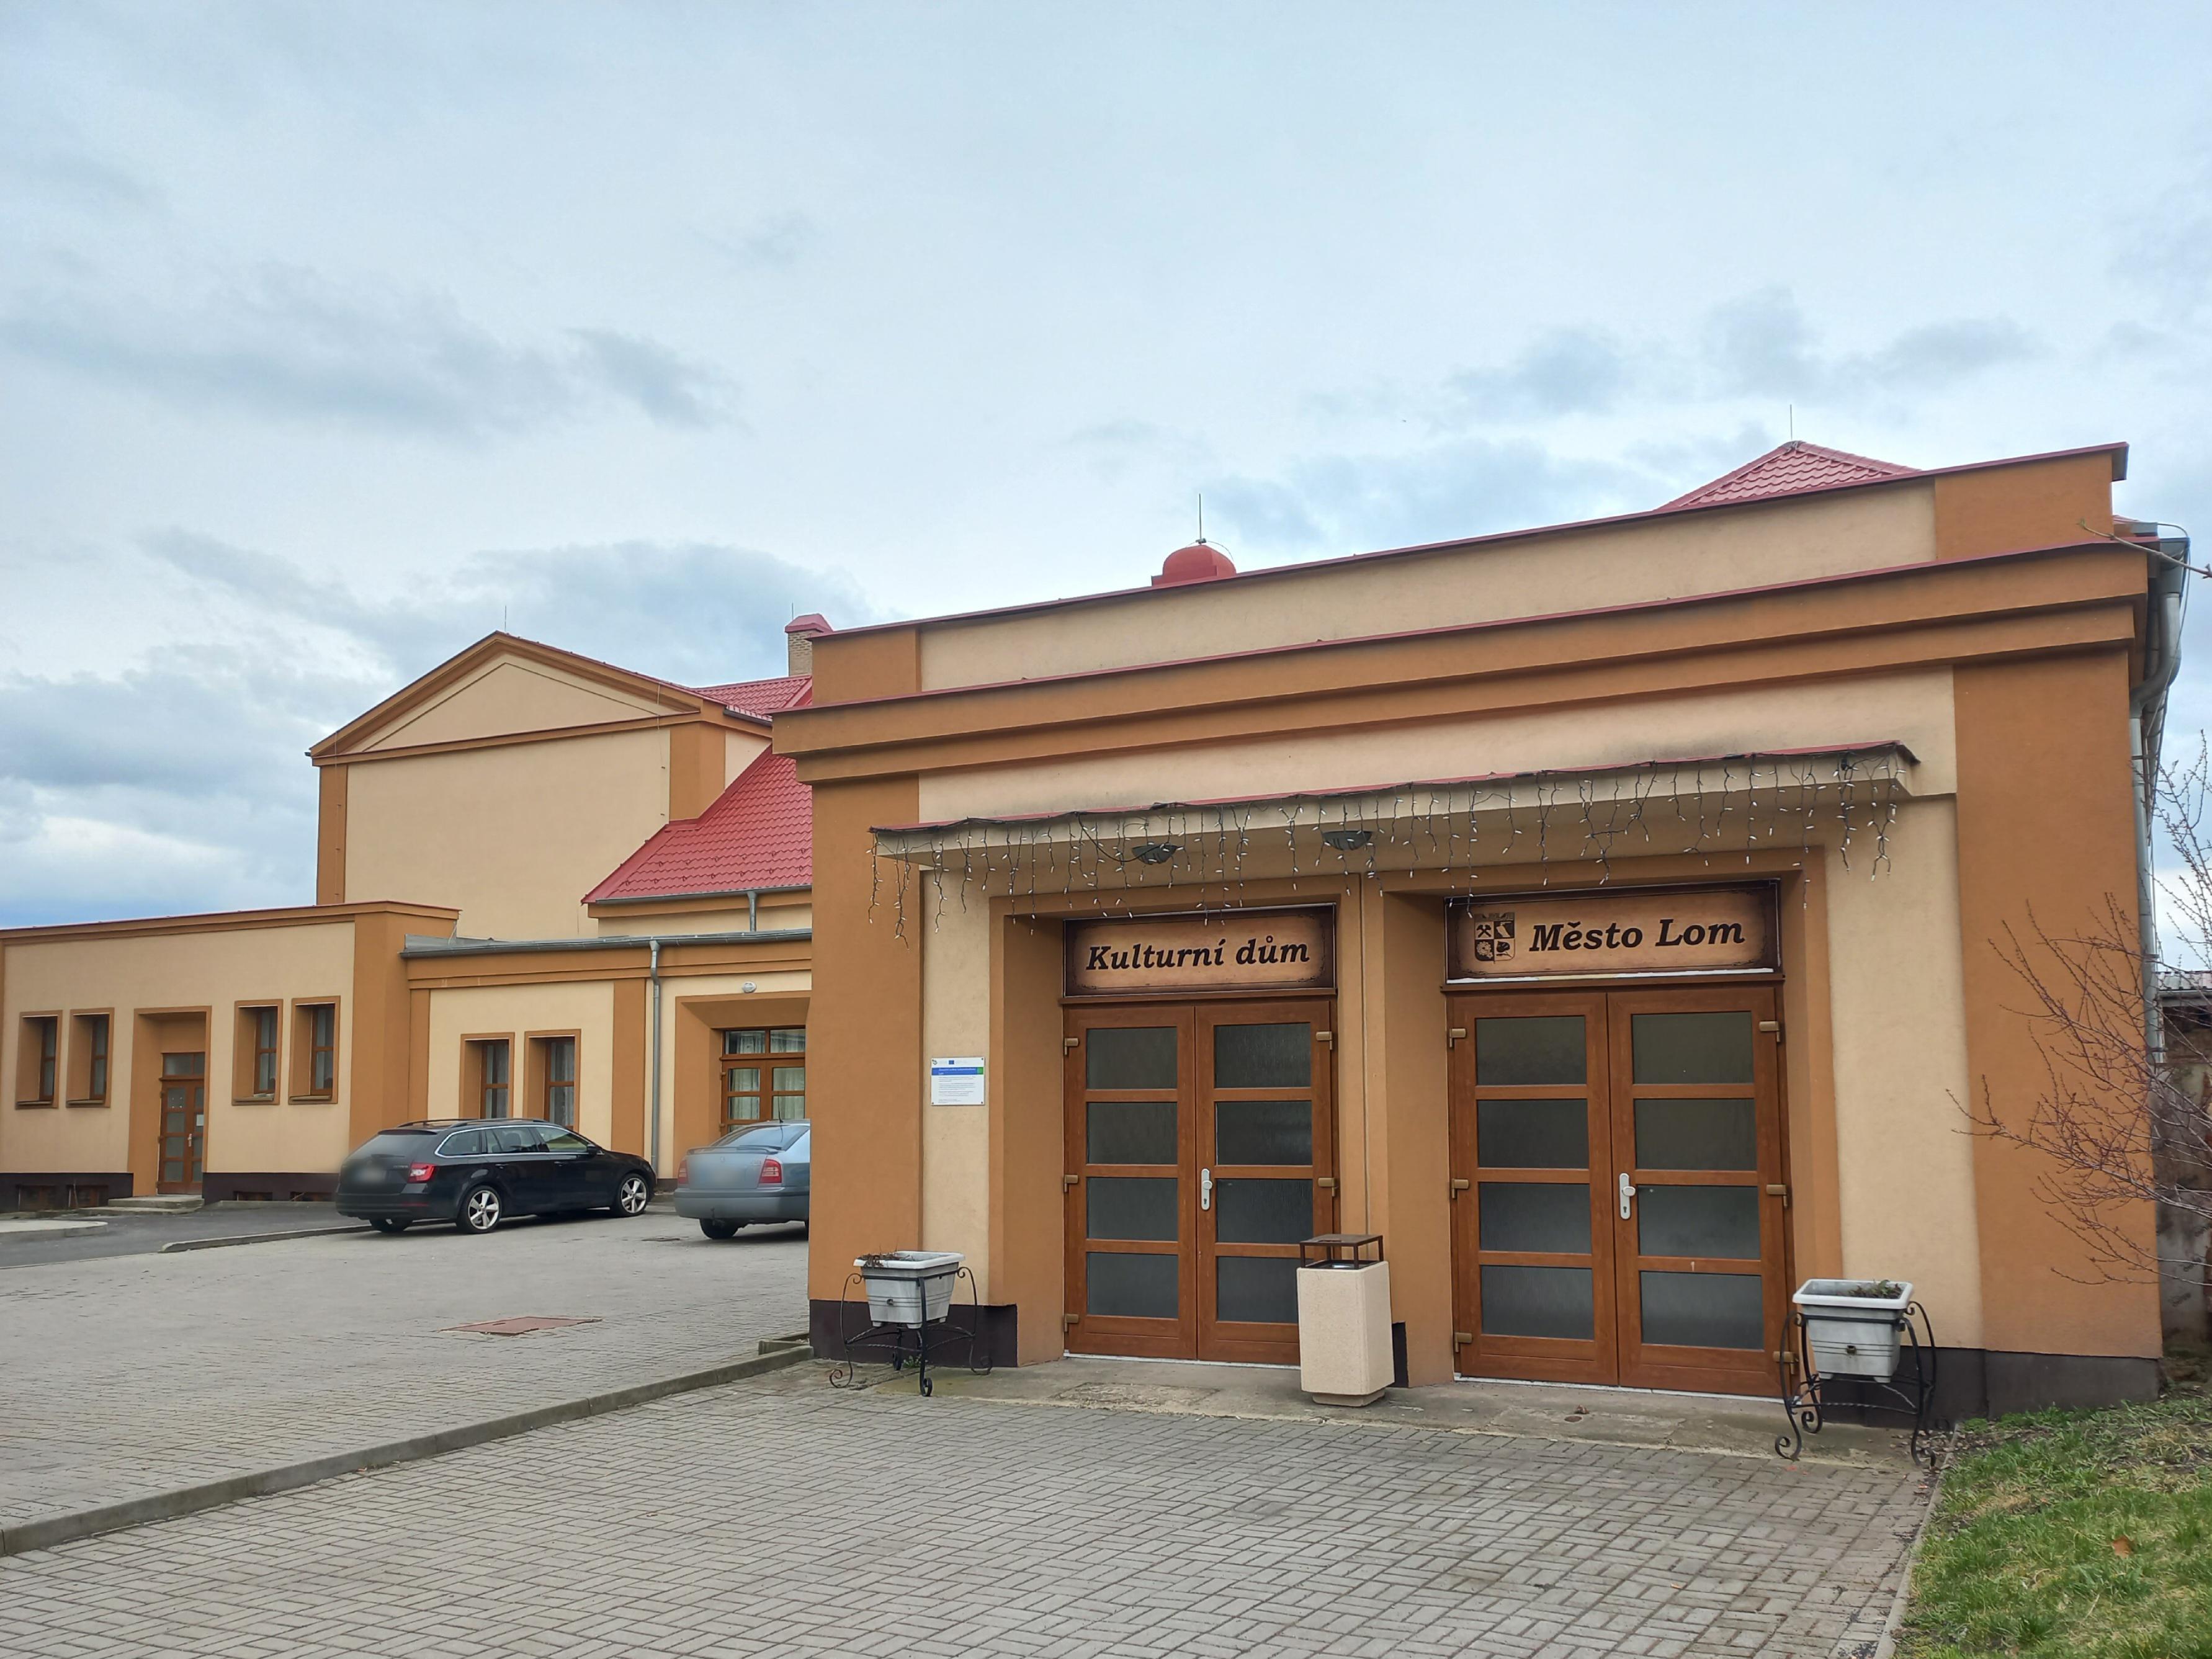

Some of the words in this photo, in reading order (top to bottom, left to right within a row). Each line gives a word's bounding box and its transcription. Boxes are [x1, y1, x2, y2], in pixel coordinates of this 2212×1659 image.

[1529, 921, 1643, 951] Město
[1655, 918, 1745, 947] Lom
[1086, 939, 1226, 970] Kulturní
[1235, 936, 1310, 964] dům
